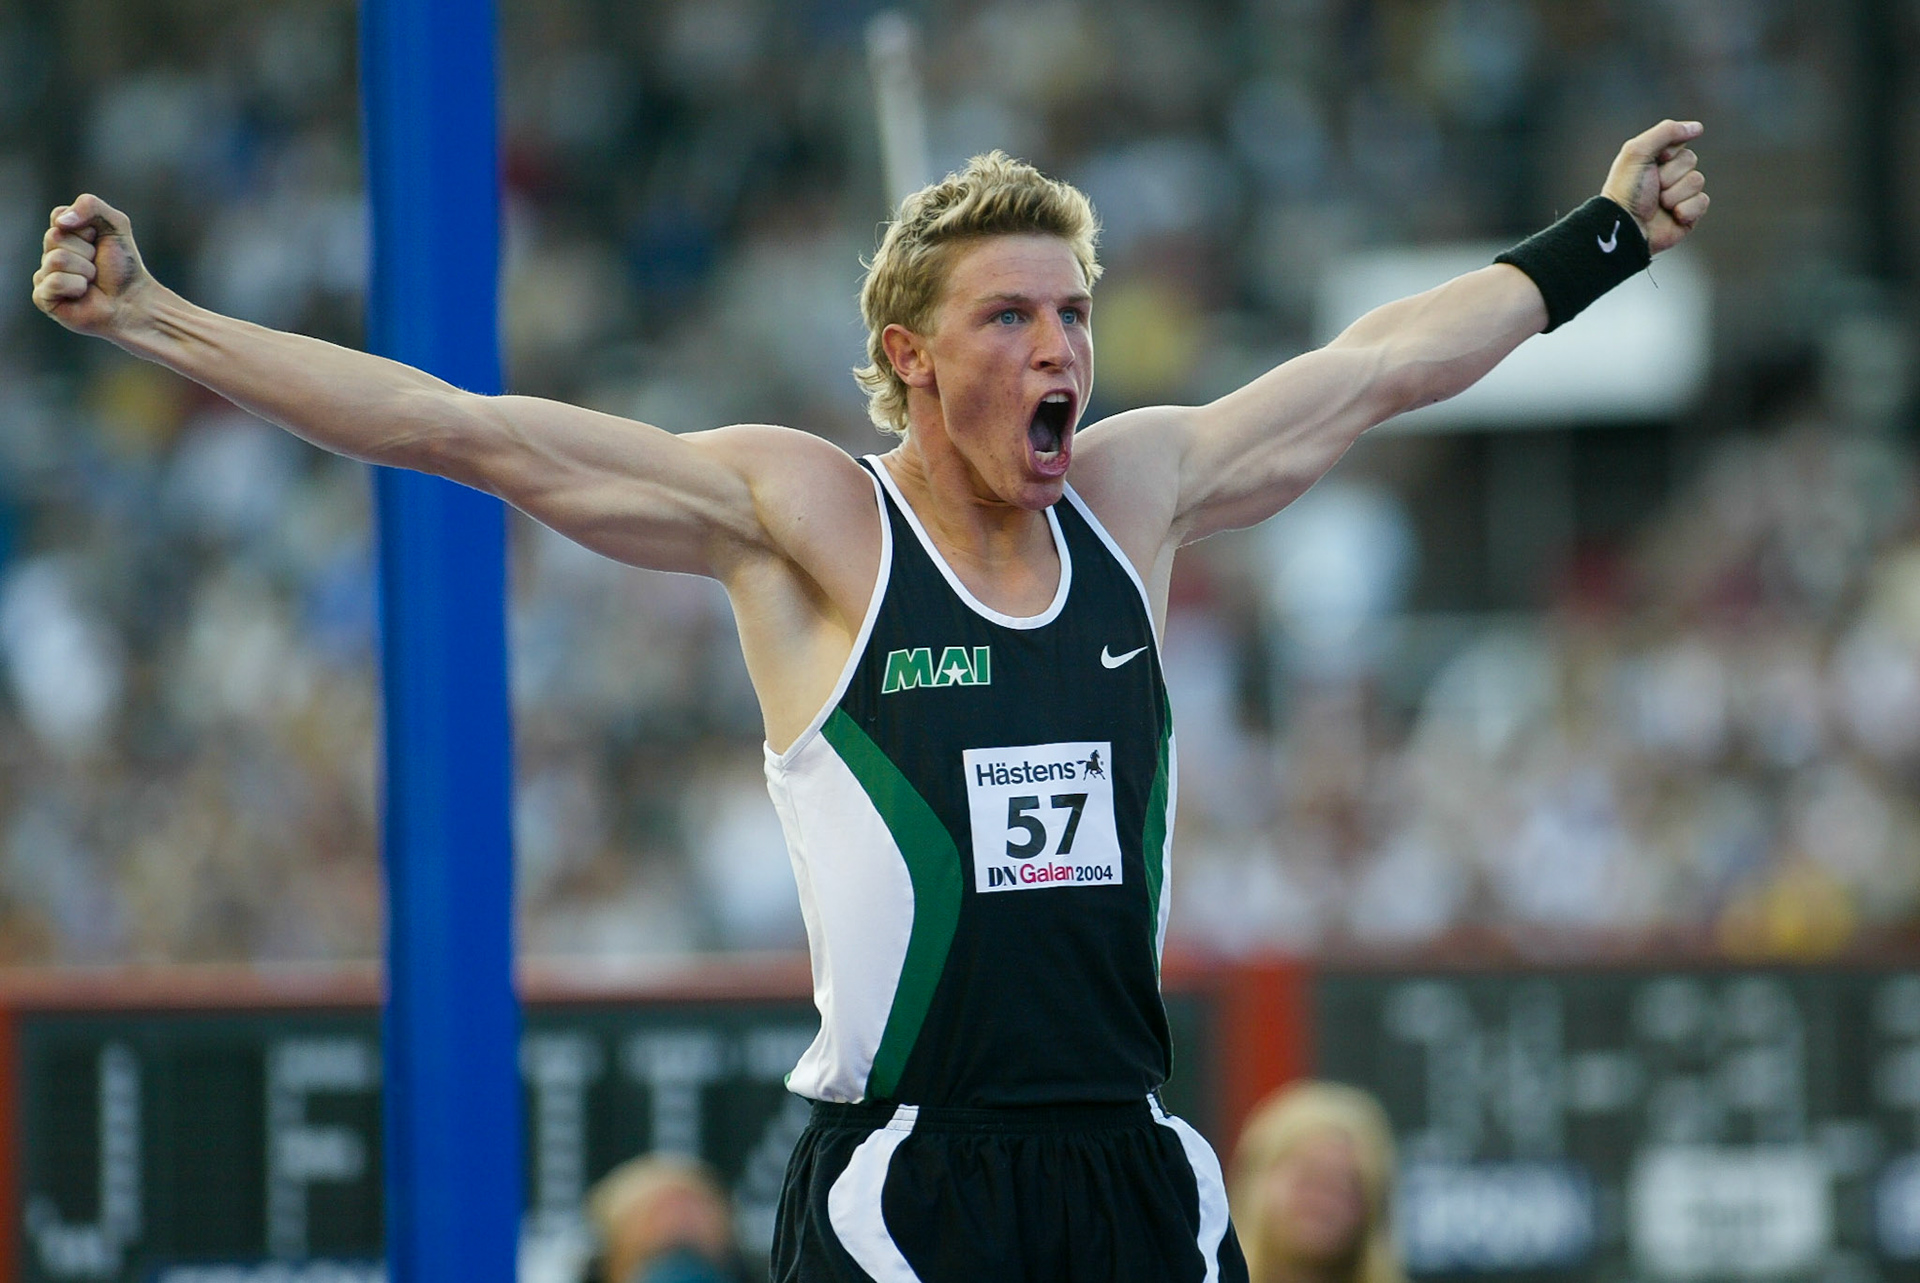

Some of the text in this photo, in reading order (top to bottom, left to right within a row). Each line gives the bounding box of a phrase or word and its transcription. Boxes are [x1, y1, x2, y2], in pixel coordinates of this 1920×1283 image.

[881, 645, 991, 694] MAI
[976, 761, 1076, 786] Hästens
[1006, 793, 1088, 859] 57
[988, 862, 1113, 887] DN Galan 2004
